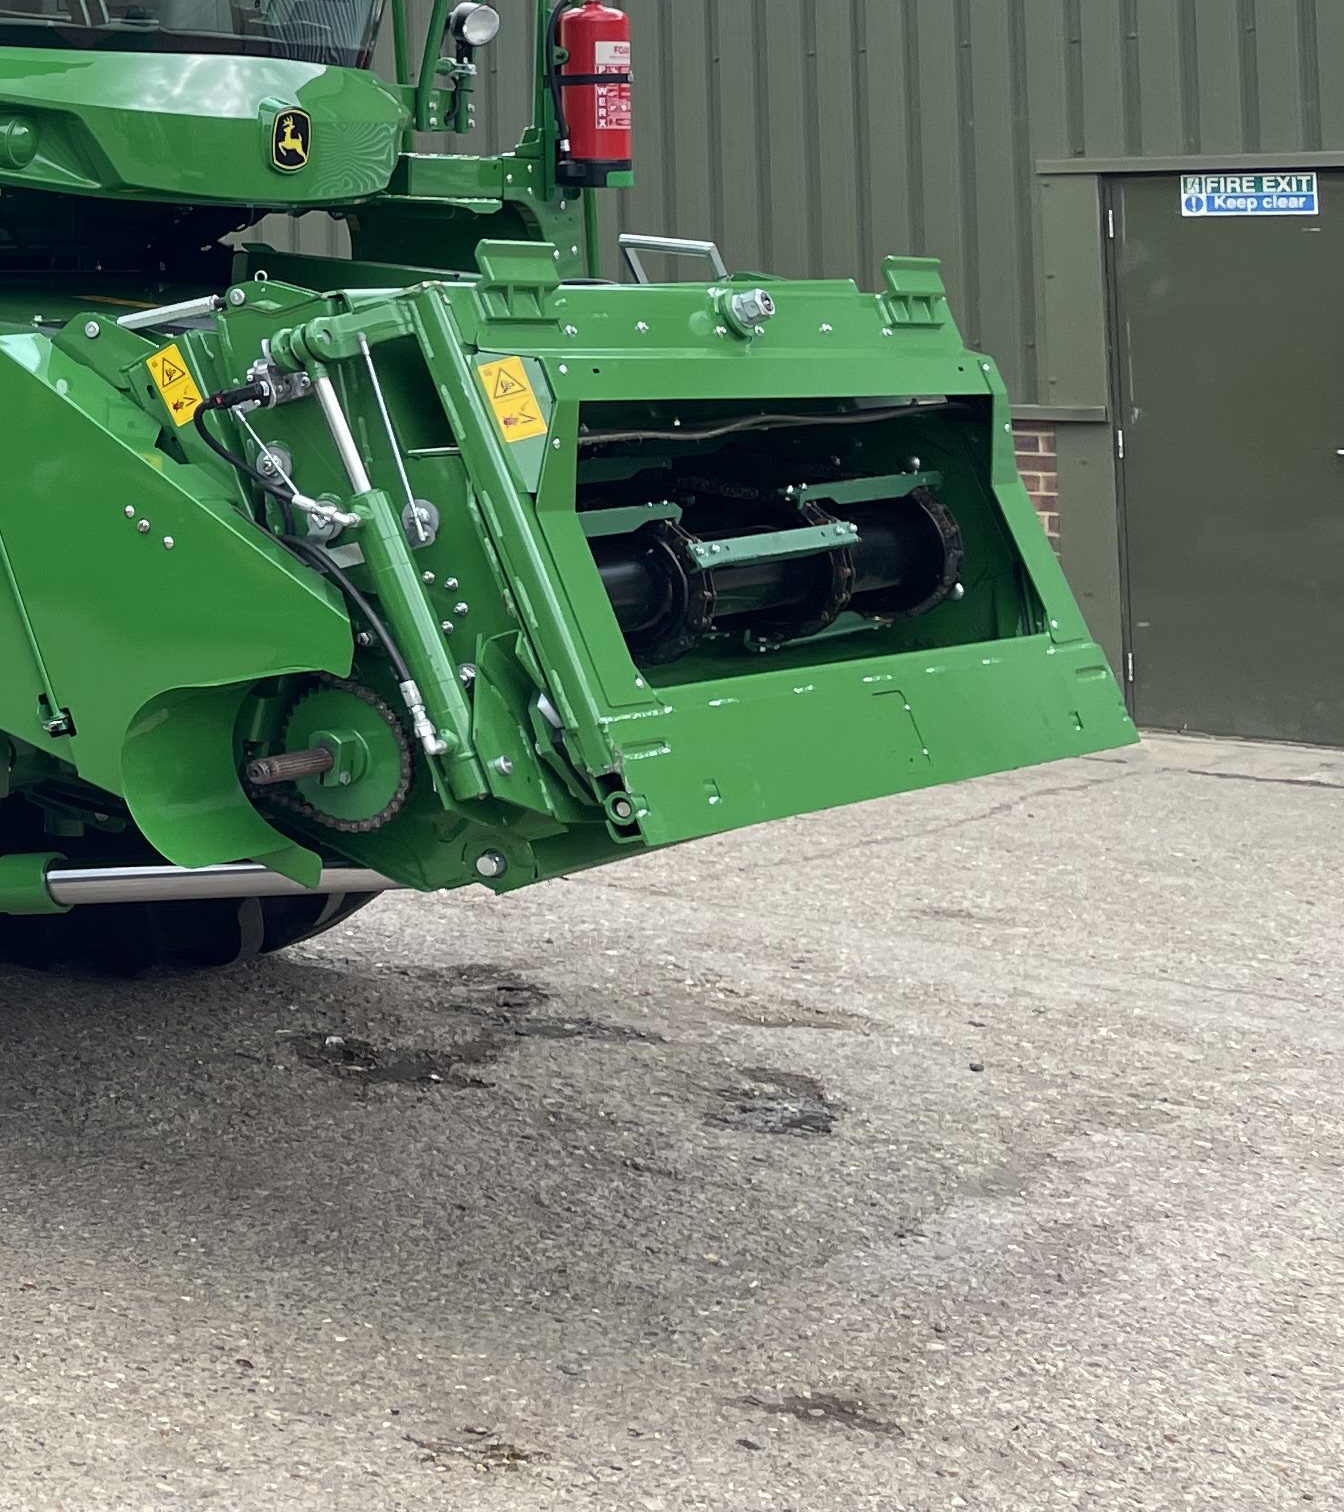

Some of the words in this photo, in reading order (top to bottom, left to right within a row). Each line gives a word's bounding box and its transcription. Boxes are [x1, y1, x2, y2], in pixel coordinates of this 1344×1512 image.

[597, 65, 608, 128] PWERX
[1206, 176, 1256, 194] FIRE
[1262, 175, 1312, 193] EXIT
[1214, 195, 1258, 213] Keep
[1262, 194, 1307, 209] clear
